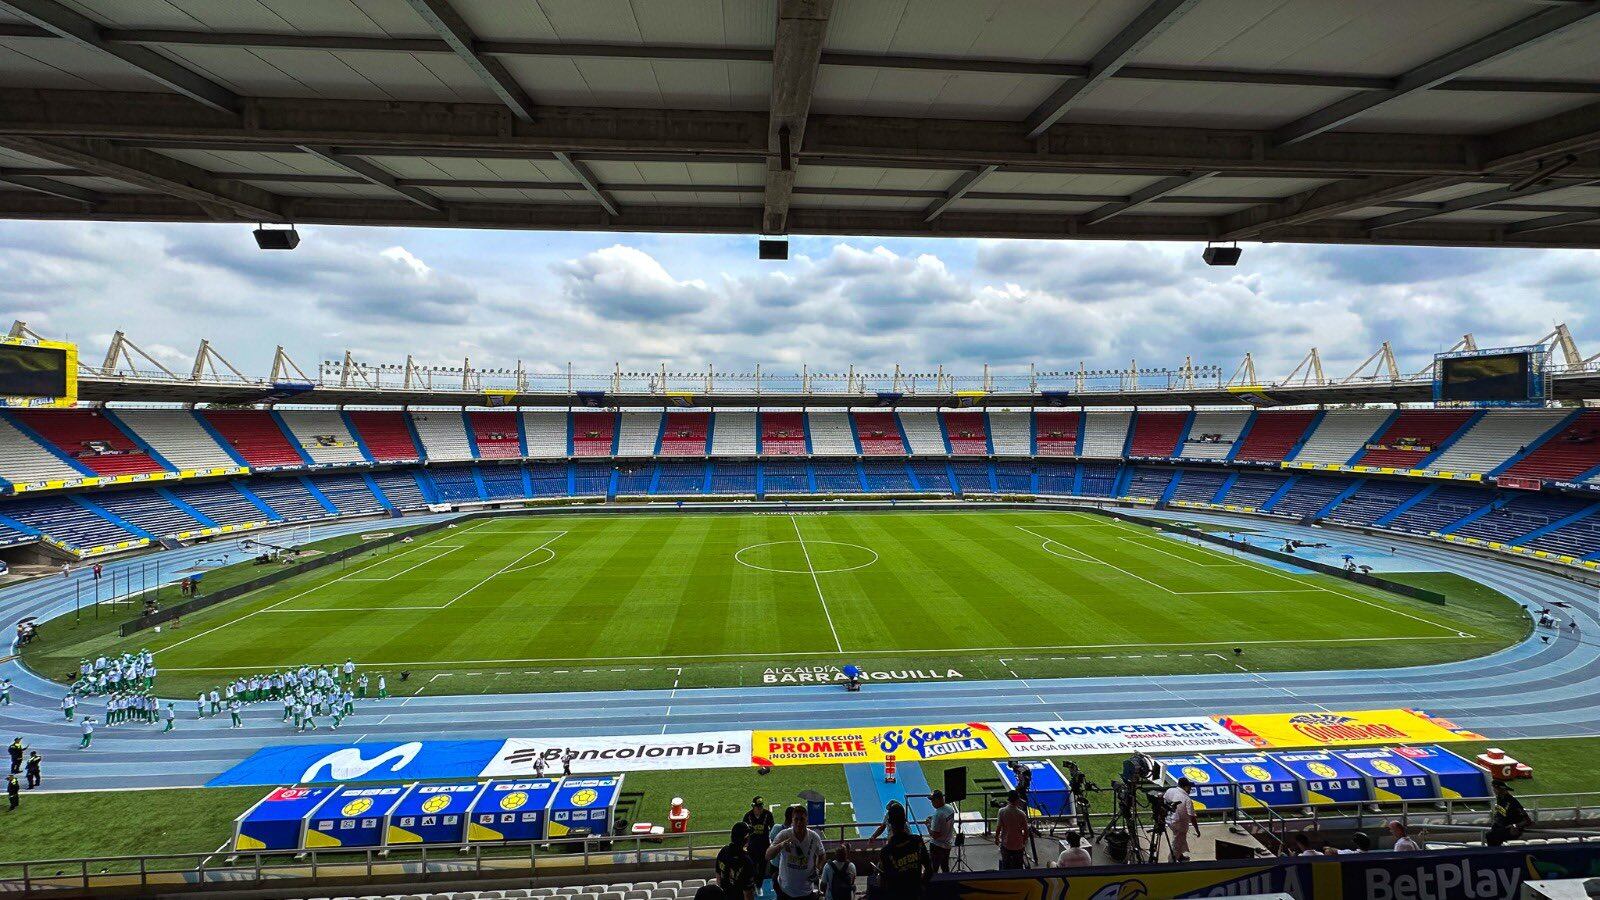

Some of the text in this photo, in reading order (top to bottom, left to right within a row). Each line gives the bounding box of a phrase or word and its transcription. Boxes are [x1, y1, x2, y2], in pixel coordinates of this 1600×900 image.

[764, 671, 963, 684] BARRANQUILLA
[1049, 723, 1206, 736] HOMECENTER
[544, 741, 741, 761] Bancolombia
[769, 739, 866, 753] PROMETE
[1030, 744, 1059, 752] CASA
[1060, 743, 1096, 751] OFICIAL
[1365, 858, 1521, 900] BetPlay
